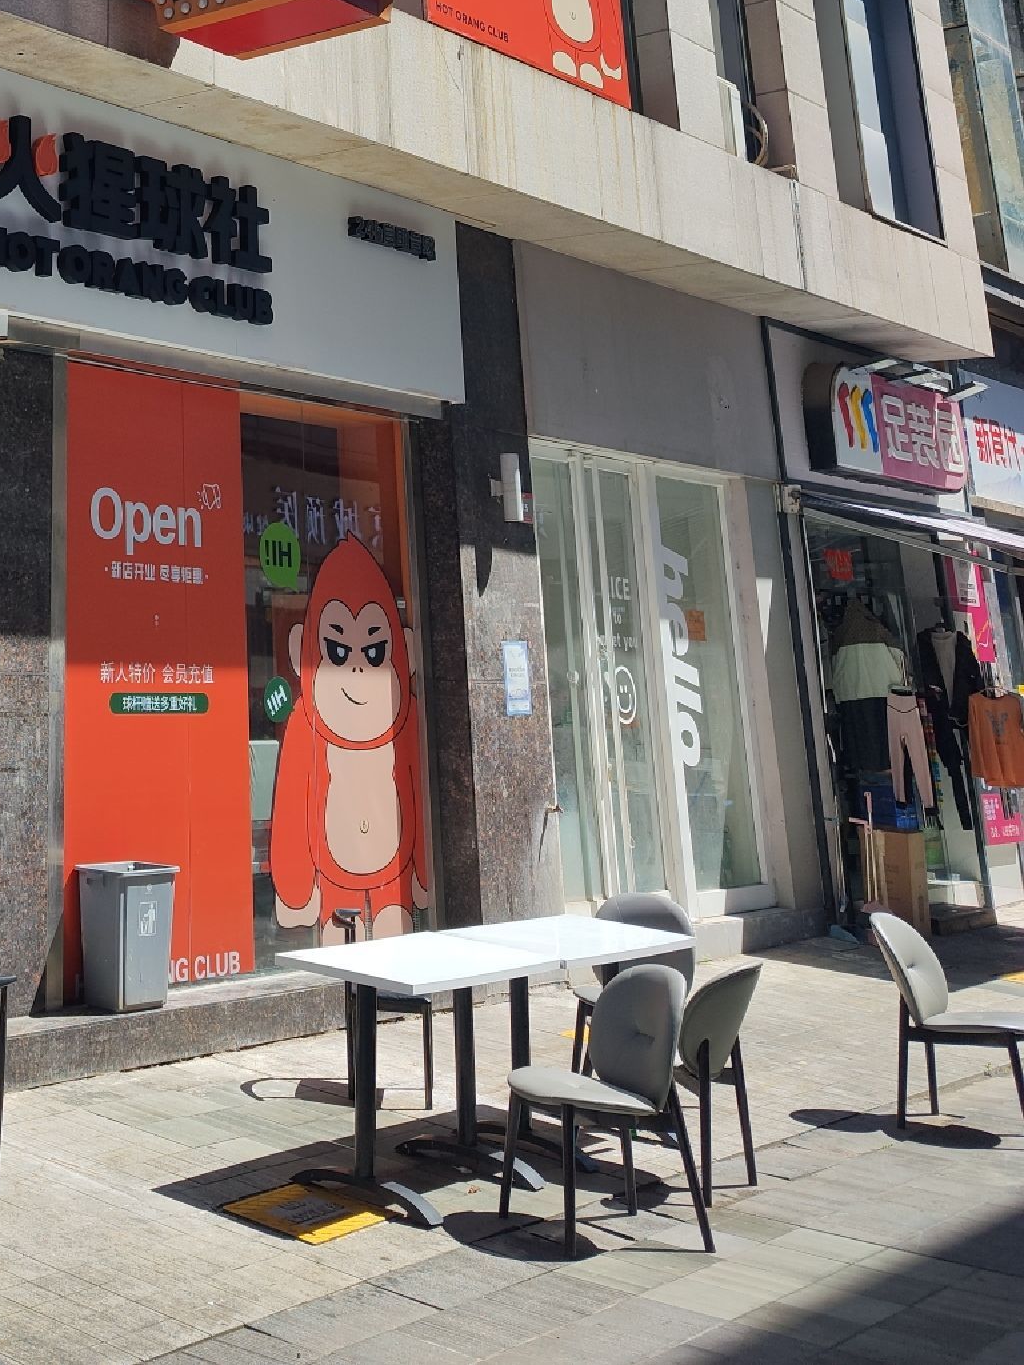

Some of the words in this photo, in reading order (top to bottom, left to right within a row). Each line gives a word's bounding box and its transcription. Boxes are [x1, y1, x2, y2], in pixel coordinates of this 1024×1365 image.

[435, 1, 454, 18] HOT
[455, 10, 487, 31] ORANG
[487, 24, 509, 43] CLUB
[57, 244, 188, 305] ORANG
[187, 275, 274, 325] CLUB
[90, 487, 203, 555] Open
[610, 576, 631, 601] ICE
[100, 661, 156, 684] 新人特价
[162, 663, 215, 685] 会员充值
[194, 951, 241, 979] CLUB
